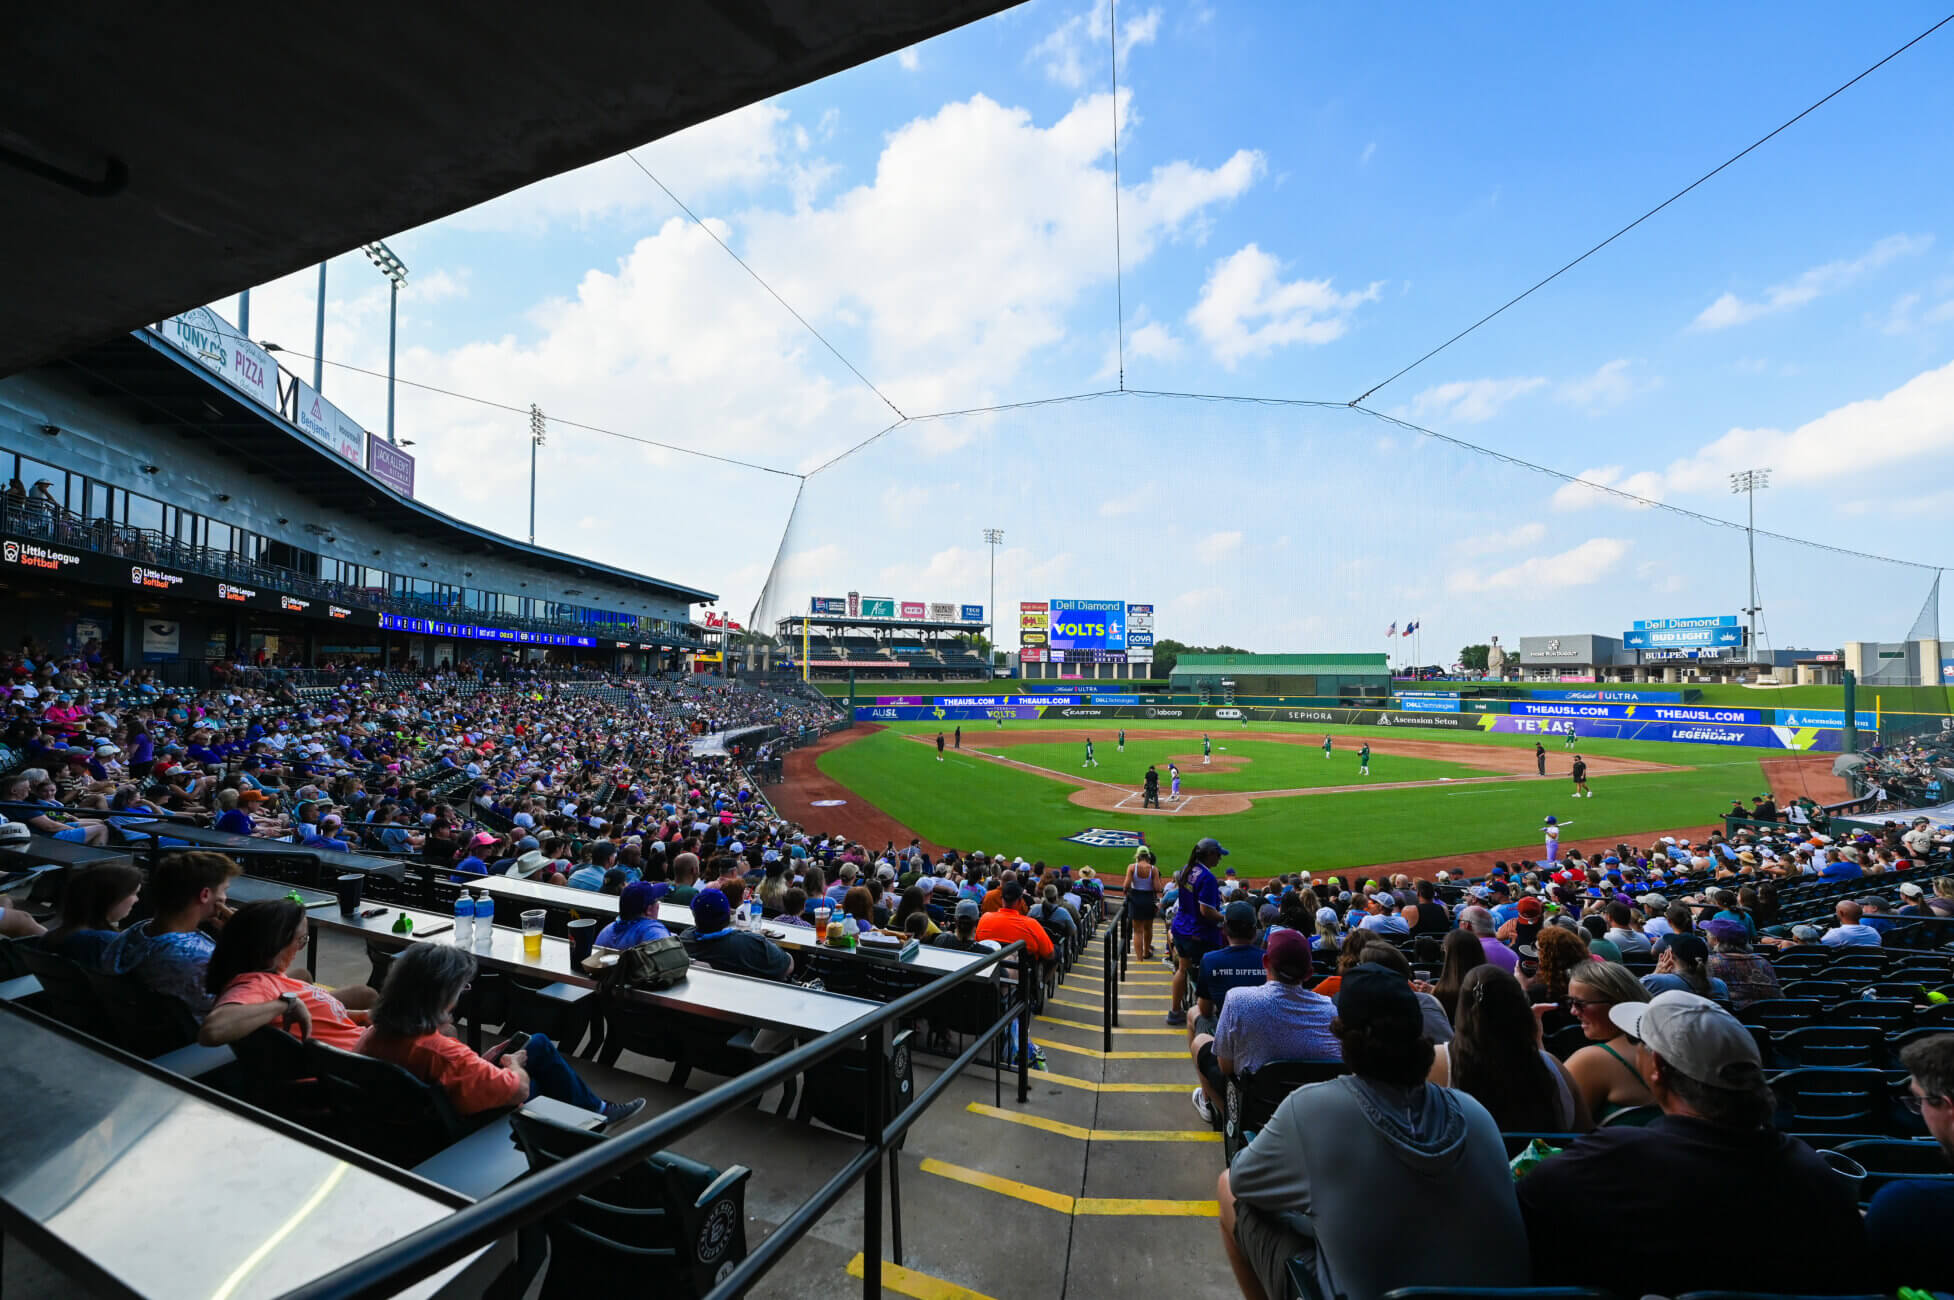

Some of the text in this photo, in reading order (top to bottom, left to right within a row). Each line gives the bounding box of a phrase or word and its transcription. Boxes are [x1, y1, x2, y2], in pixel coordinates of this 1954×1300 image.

[176, 316, 208, 350] TONY
[235, 350, 265, 390] PIZZA
[301, 411, 330, 441] Benjamin
[377, 446, 408, 475] JACK ALLEN'S
[21, 544, 80, 565] Little League
[20, 554, 59, 569] Softball
[143, 568, 183, 584] Little League
[143, 577, 169, 588] Softball
[227, 584, 256, 598] Little League
[1056, 600, 1075, 610] Dell
[1077, 600, 1120, 611] Diamond
[1644, 617, 1720, 630] Dell Diamond
[1052, 623, 1105, 637] VOLTS
[1129, 635, 1152, 643] GOYA
[1651, 631, 1711, 642] BUD LIGHT
[1645, 648, 1719, 660] BULLPEN BAR
[1018, 697, 1071, 705] THEAUSL.COM
[1604, 692, 1639, 700] ULTRA
[943, 698, 995, 706] THEAUSL.COM
[872, 708, 897, 716] AUSL
[986, 709, 1017, 718] VOLTS
[1157, 708, 1183, 717] labcorp
[1288, 711, 1333, 720] SEPHORA
[1525, 705, 1609, 716] THEAUSL.COM
[1655, 708, 1745, 722] THEAUSL.COM
[1393, 716, 1458, 726] Ascension Seton
[1515, 719, 1575, 733] TEXAS
[1801, 716, 1843, 725] Ascension
[1672, 730, 1745, 742] LEGENDARY
